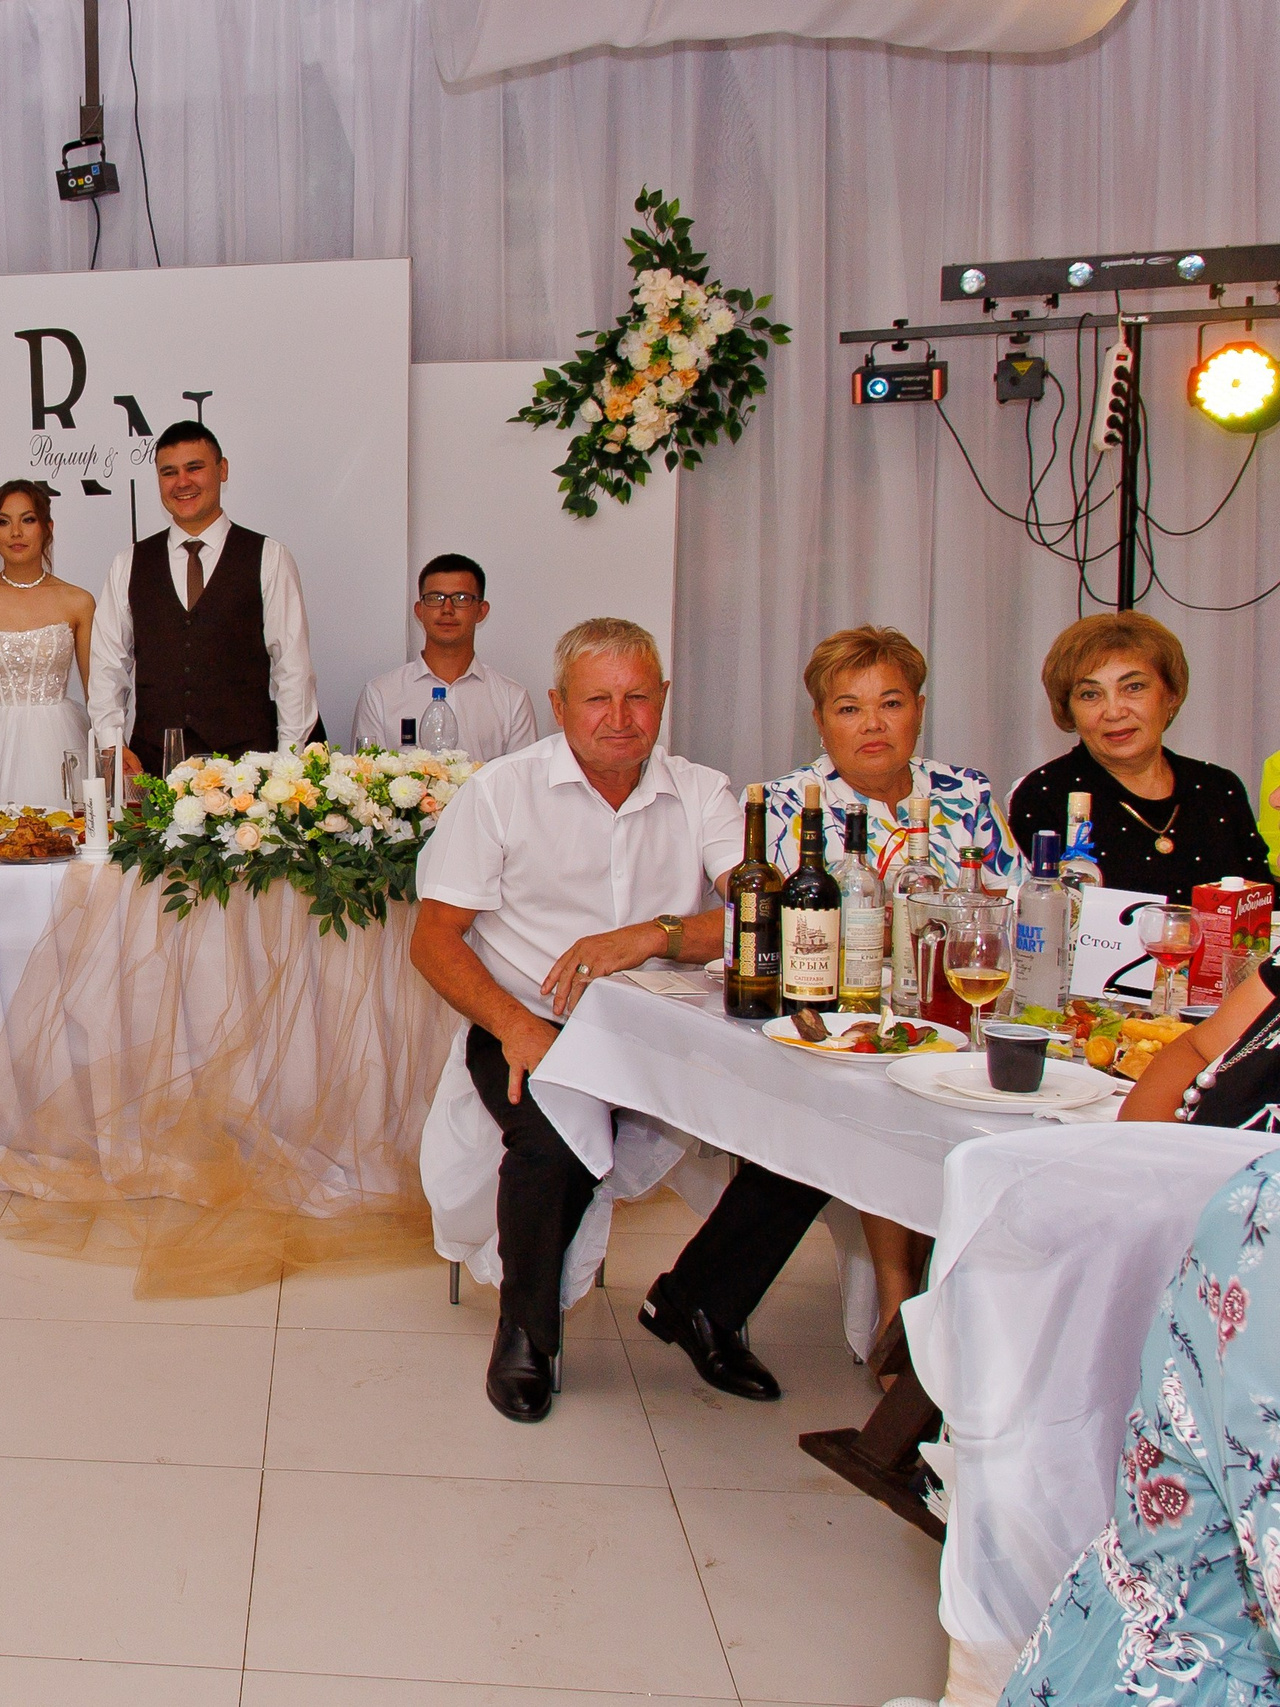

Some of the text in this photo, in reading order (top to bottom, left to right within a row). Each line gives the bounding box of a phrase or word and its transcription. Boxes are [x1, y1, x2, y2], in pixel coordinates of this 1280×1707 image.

[29, 434, 99, 479] Радмир
[103, 446, 118, 478] &
[1234, 891, 1273, 920] Любимый
[1079, 933, 1122, 951] Стол
[1102, 900, 1166, 1000] 2
[789, 960, 829, 970] КРЫМ
